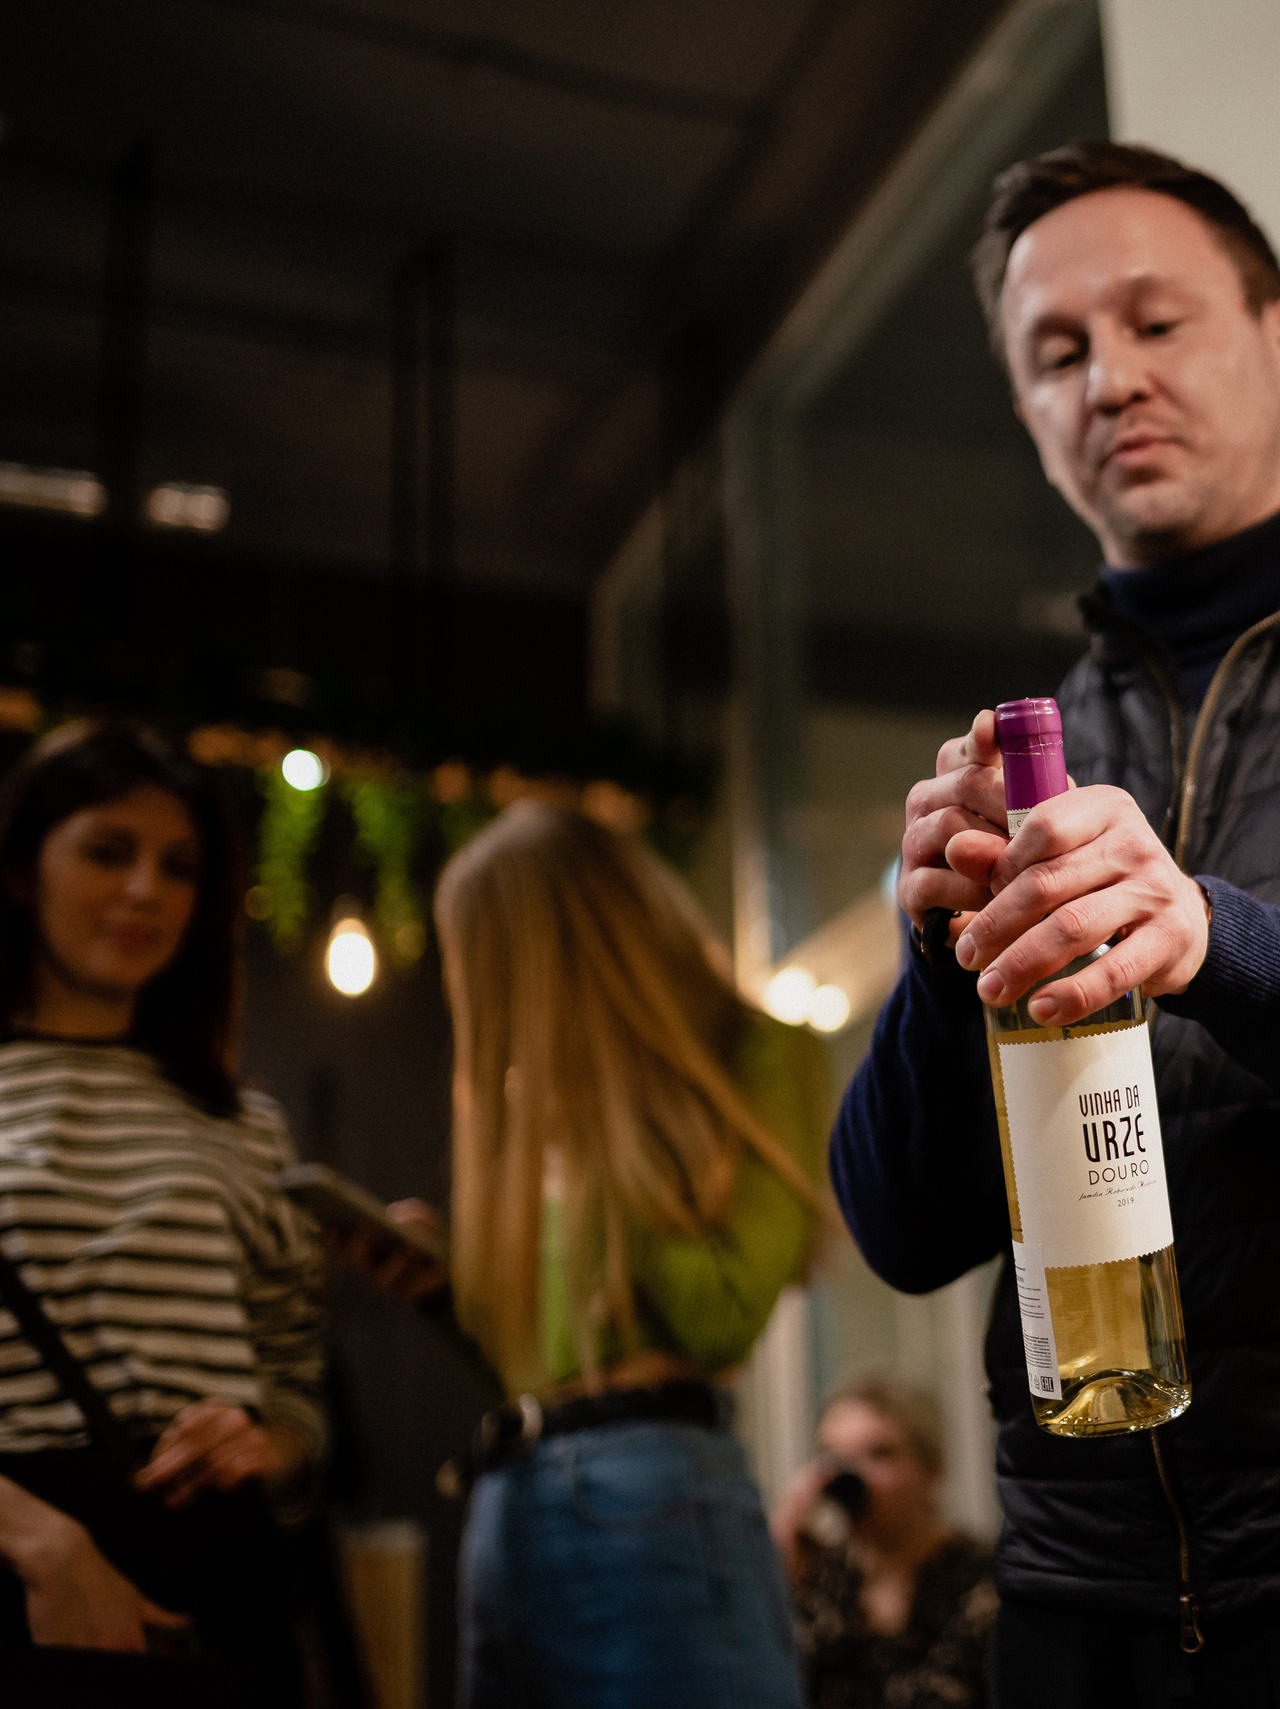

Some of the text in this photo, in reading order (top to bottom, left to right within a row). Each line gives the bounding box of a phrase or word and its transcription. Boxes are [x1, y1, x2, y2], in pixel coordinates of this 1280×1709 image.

[1079, 1084, 1141, 1117] VINHA DA
[1082, 1113, 1146, 1163] URZE
[1088, 1159, 1149, 1186] DOURO
[1117, 1196, 1135, 1207] 2019
